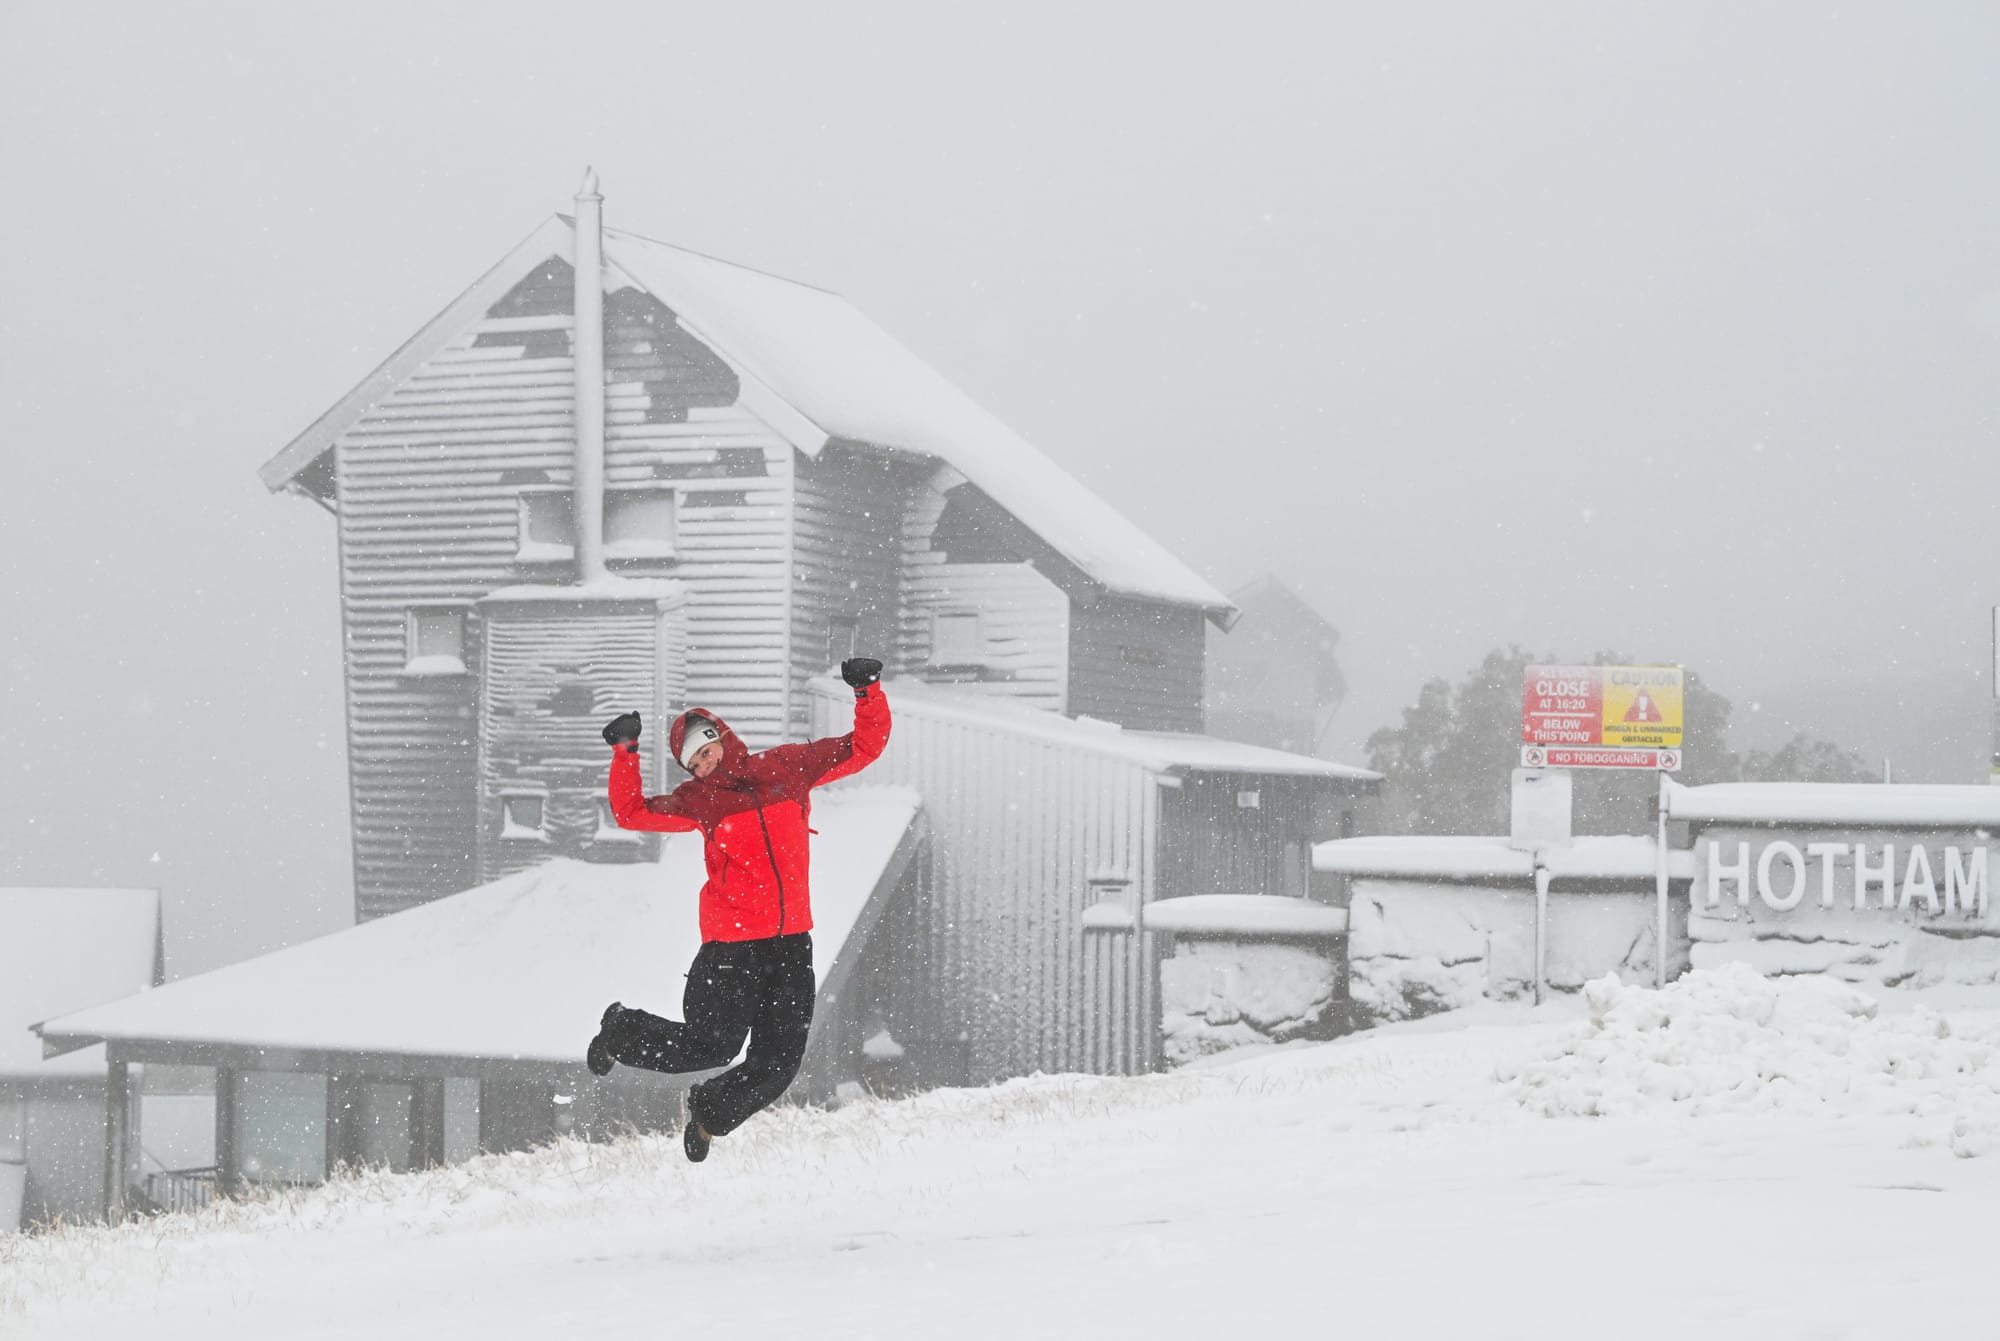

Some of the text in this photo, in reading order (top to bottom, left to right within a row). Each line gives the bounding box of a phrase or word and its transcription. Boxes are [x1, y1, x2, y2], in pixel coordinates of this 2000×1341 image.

[1611, 671, 1677, 686] CAUTION
[1536, 680, 1589, 697] CLOSE
[1540, 699, 1586, 710] AT 16:20
[1543, 719, 1580, 730] BELOW
[1534, 730, 1591, 742] THIS POINT
[1622, 736, 1663, 744] OBSTACLES
[1556, 753, 1648, 764] NO TOBOGGANING
[1708, 840, 1988, 918] HOTHAM
